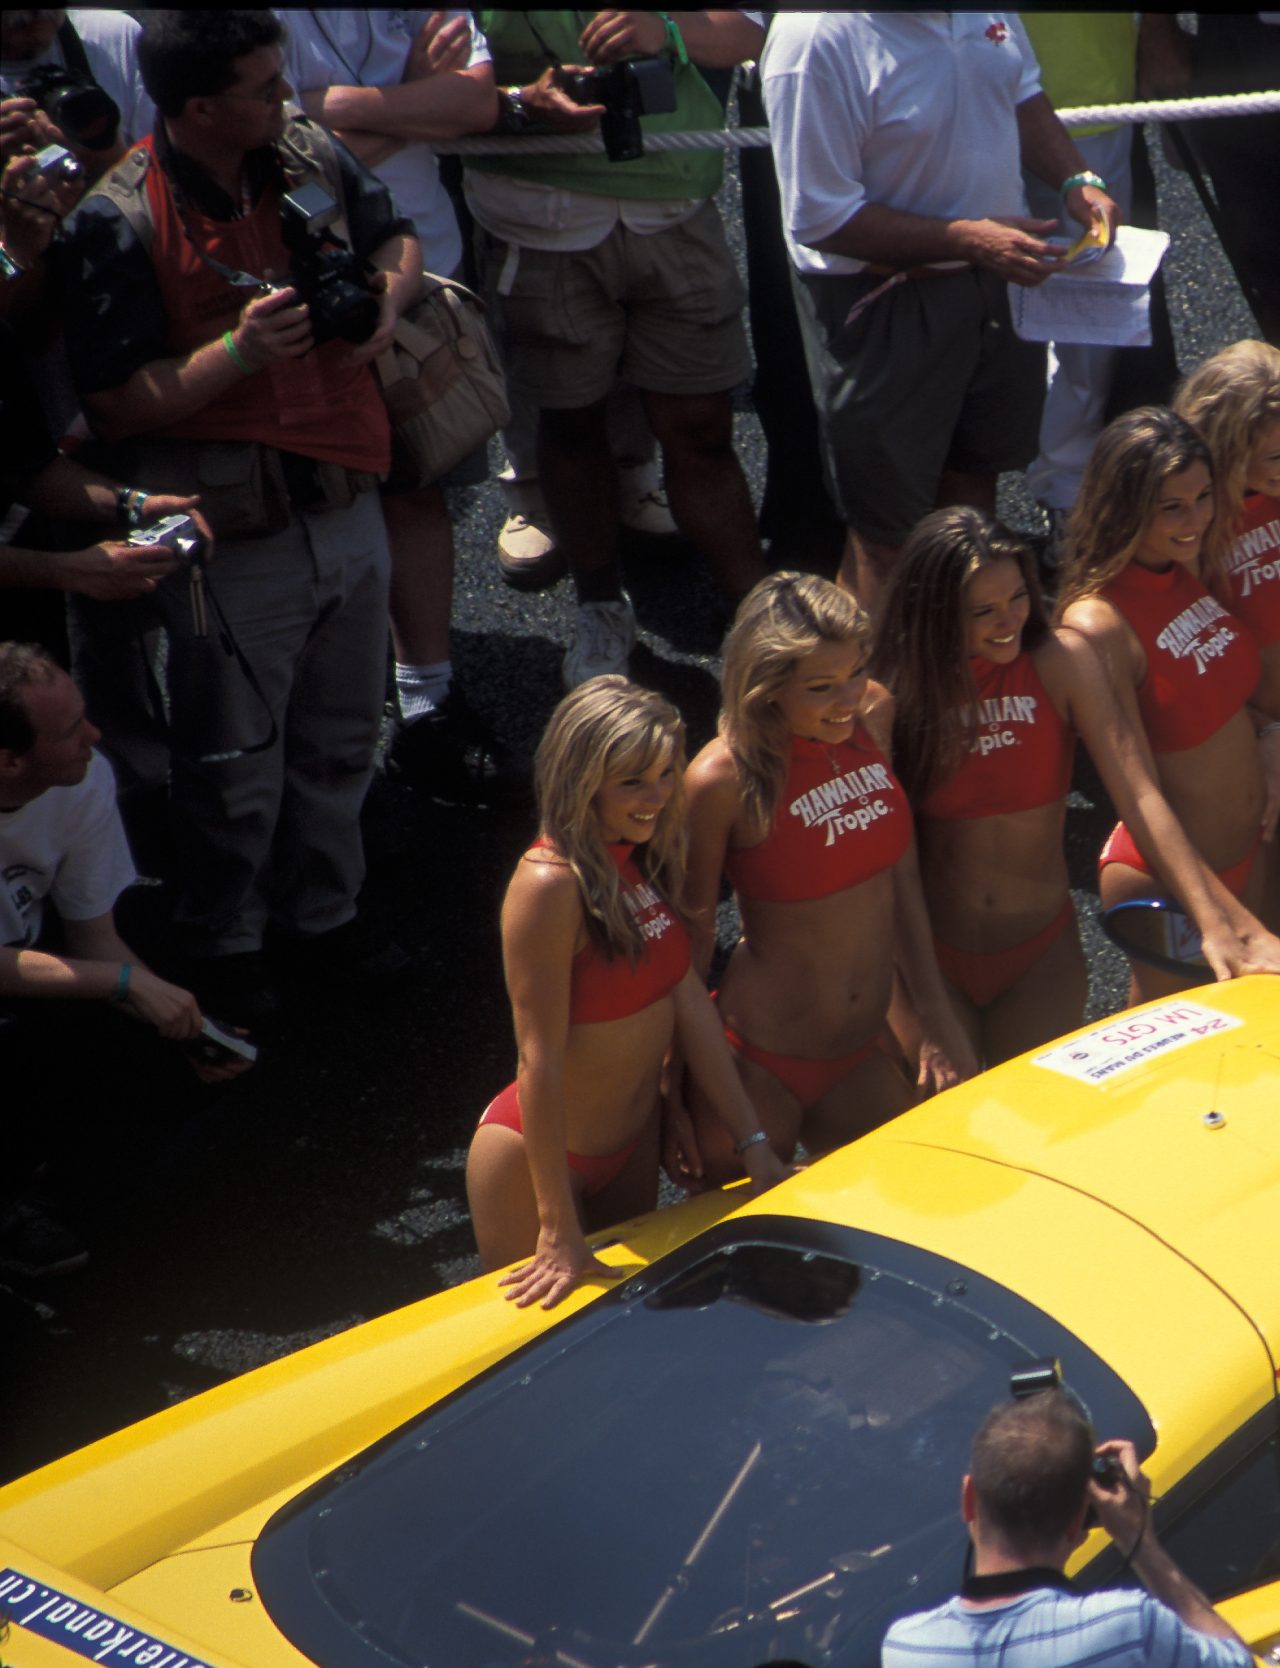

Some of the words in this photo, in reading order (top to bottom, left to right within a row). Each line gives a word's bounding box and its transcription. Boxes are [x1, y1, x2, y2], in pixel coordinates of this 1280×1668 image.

[1180, 637, 1235, 675] Tropic
[969, 730, 1016, 756] pic
[789, 762, 894, 828] HAWAIIAN
[811, 807, 889, 847] Tropic
[634, 912, 671, 942] ropic
[1154, 1007, 1203, 1025] LM
[1190, 1018, 1228, 1035] 24
[1102, 1023, 1158, 1046] GTS
